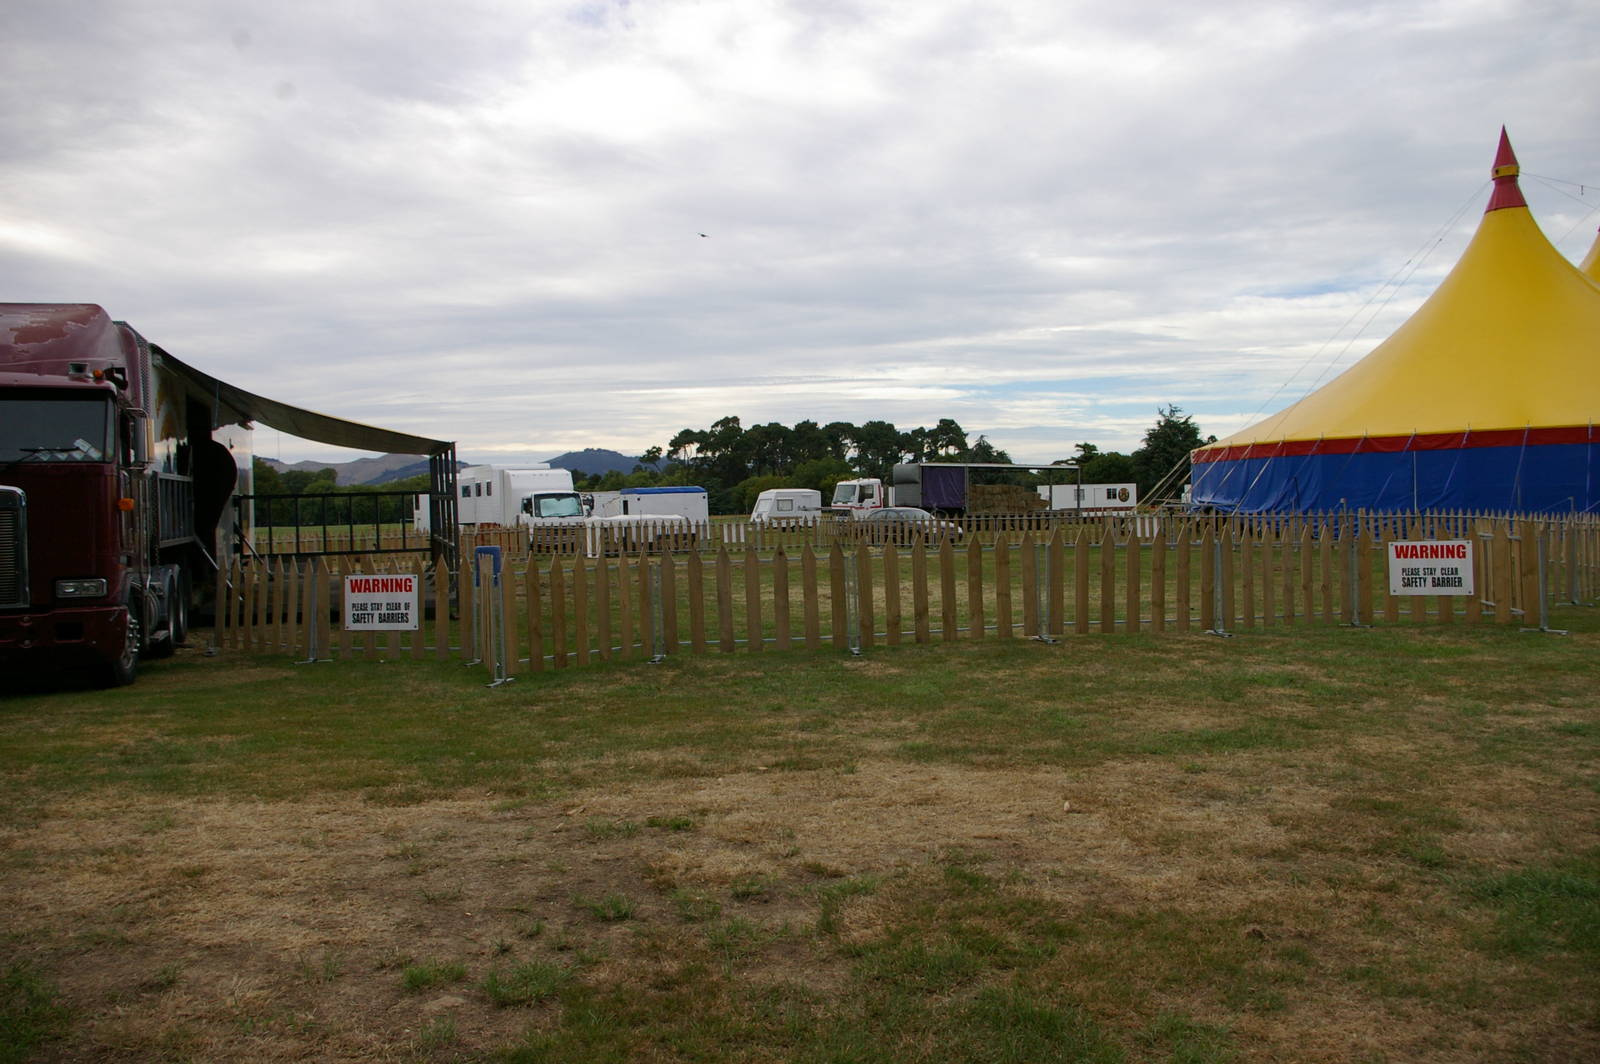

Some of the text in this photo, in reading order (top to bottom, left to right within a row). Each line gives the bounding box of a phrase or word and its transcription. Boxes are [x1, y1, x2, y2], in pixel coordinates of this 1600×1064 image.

[1394, 544, 1467, 559] WARNING
[1402, 568, 1458, 576] PLEASE STAY CLEAR
[350, 578, 412, 593] WARNING
[1402, 576, 1463, 588] SAFETY BARRIER
[352, 602, 410, 611] PLEASE STAY CLEAR OF
[352, 612, 409, 624] SAFETY BARRIERS
